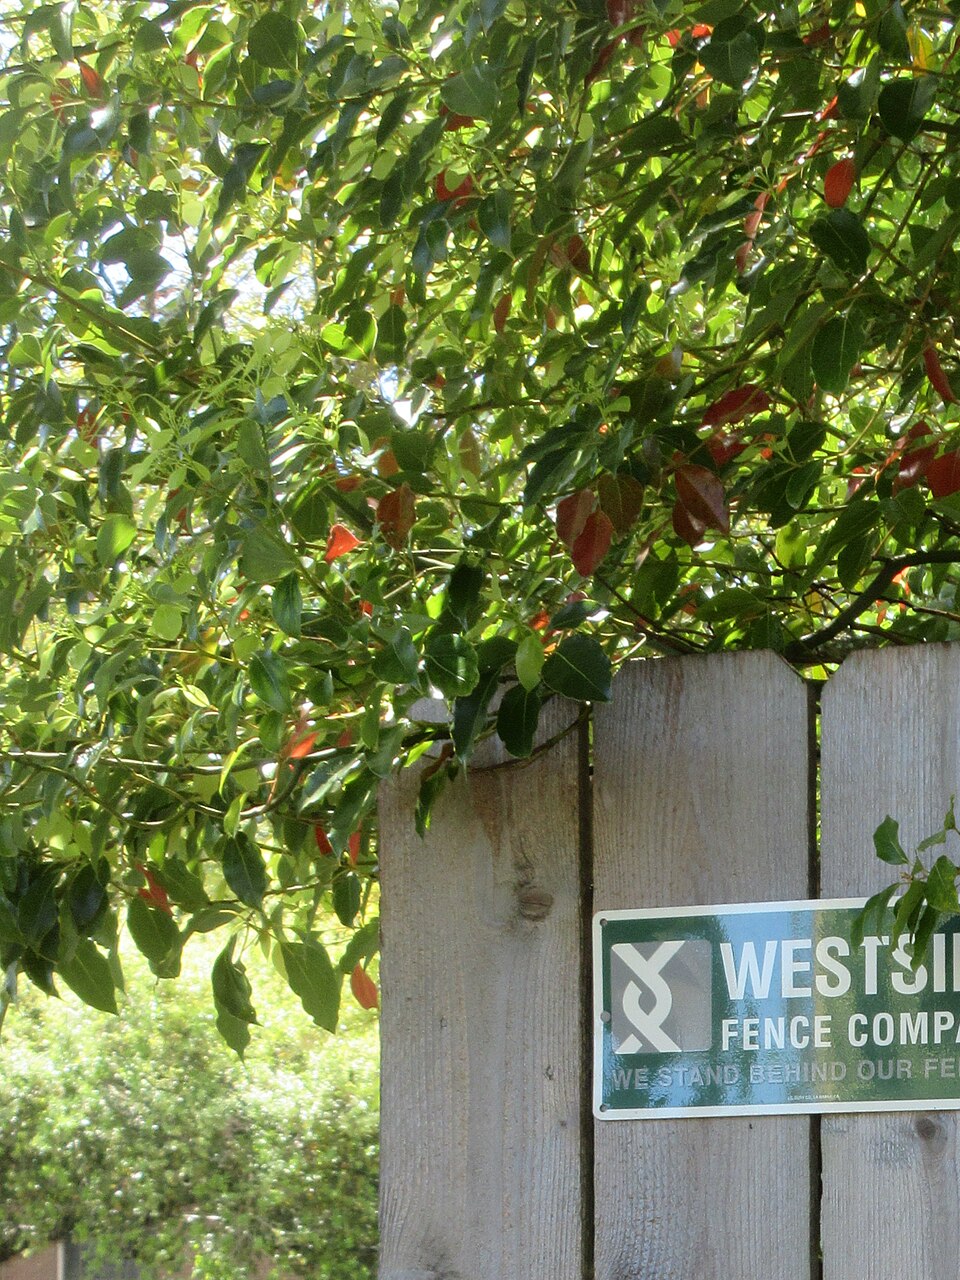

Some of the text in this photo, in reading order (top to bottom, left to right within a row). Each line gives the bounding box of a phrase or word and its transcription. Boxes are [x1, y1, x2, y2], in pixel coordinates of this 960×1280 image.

[721, 1015, 832, 1051] FENCE
[612, 1068, 649, 1091] WE
[658, 1064, 739, 1088] STAND
[750, 1060, 847, 1085] BEHIND
[857, 1059, 913, 1081] OUR
